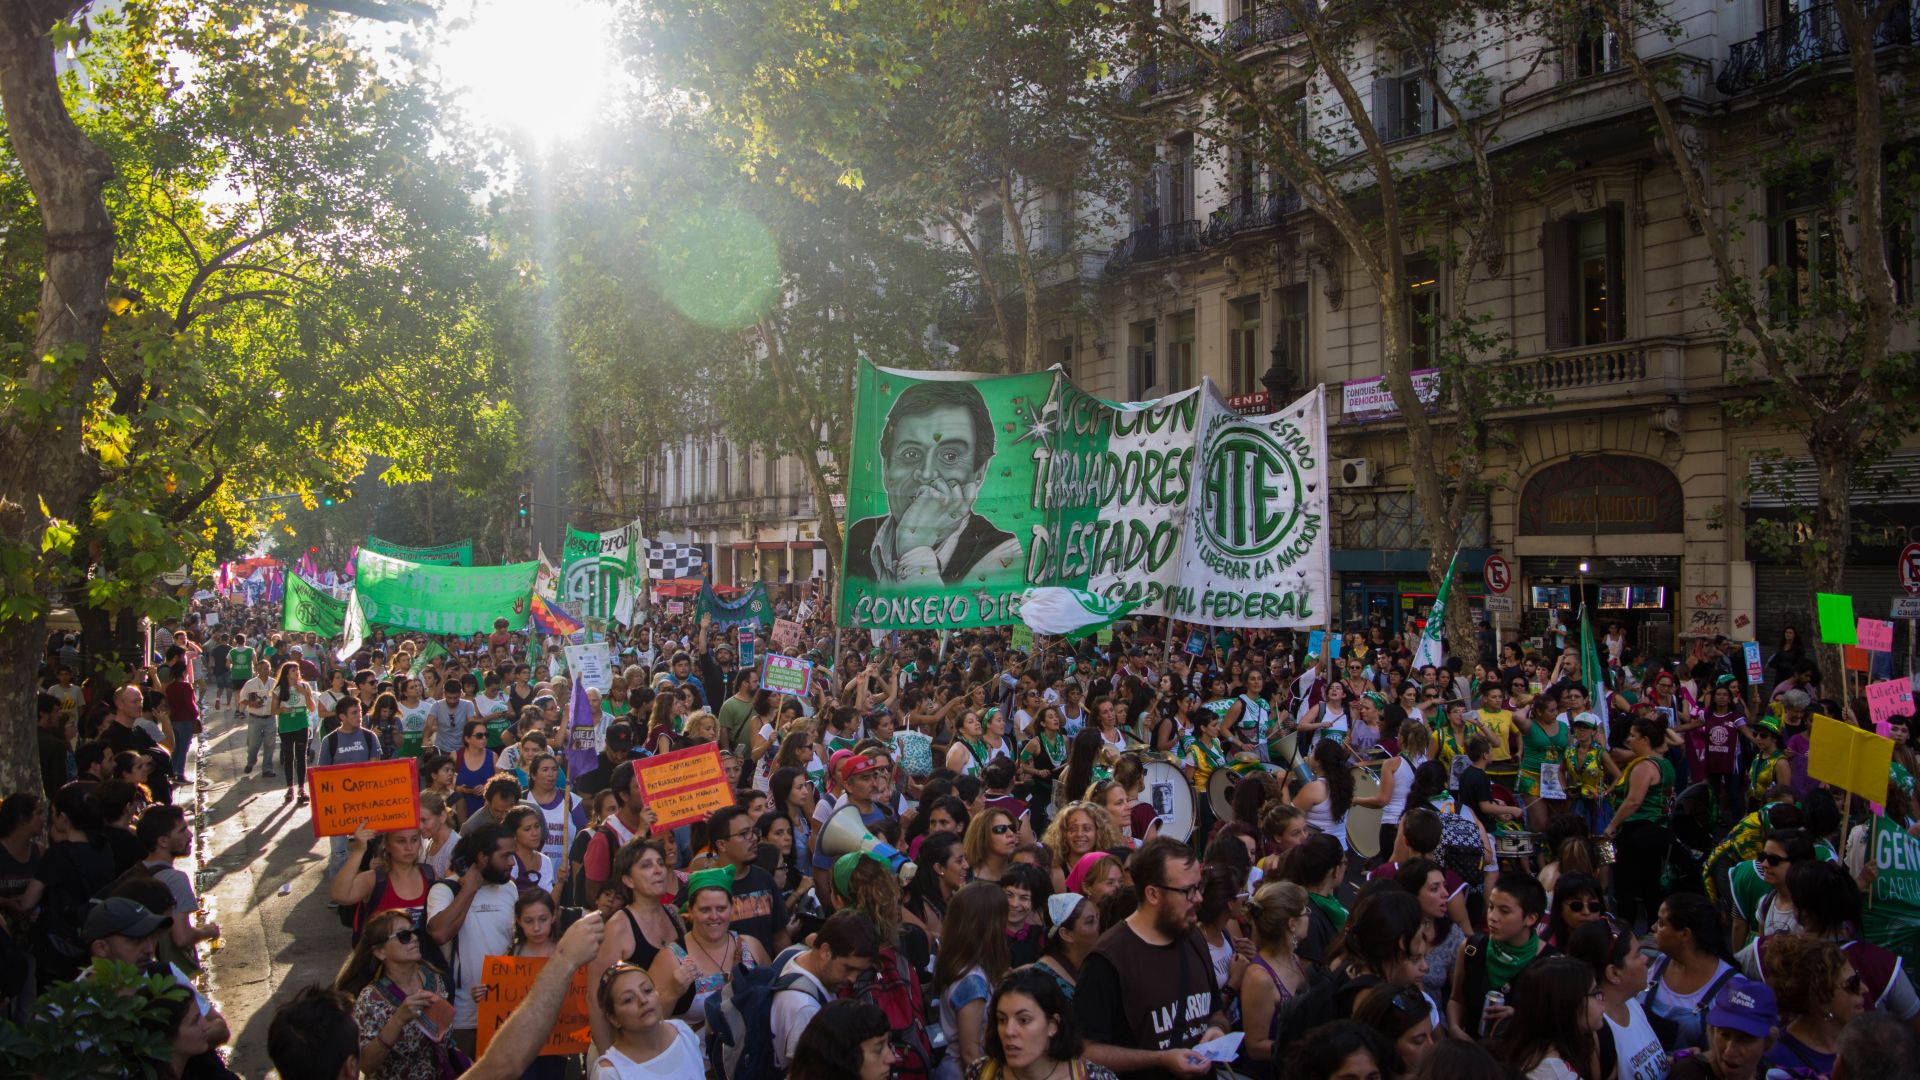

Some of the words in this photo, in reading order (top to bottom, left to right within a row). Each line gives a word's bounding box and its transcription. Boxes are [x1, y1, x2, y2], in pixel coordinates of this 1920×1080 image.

[1270, 420, 1315, 470] ESTADO
[1206, 438, 1285, 547] ATE
[1062, 517, 1181, 579] ESTADO
[1256, 556, 1275, 581] LA
[1277, 512, 1321, 572] NACION
[853, 594, 969, 626] CONSEJO
[1200, 590, 1315, 621] FEDERAL
[343, 797, 410, 814] PATRIARCADO
[491, 962, 510, 977] EN
[514, 963, 531, 977] MI
